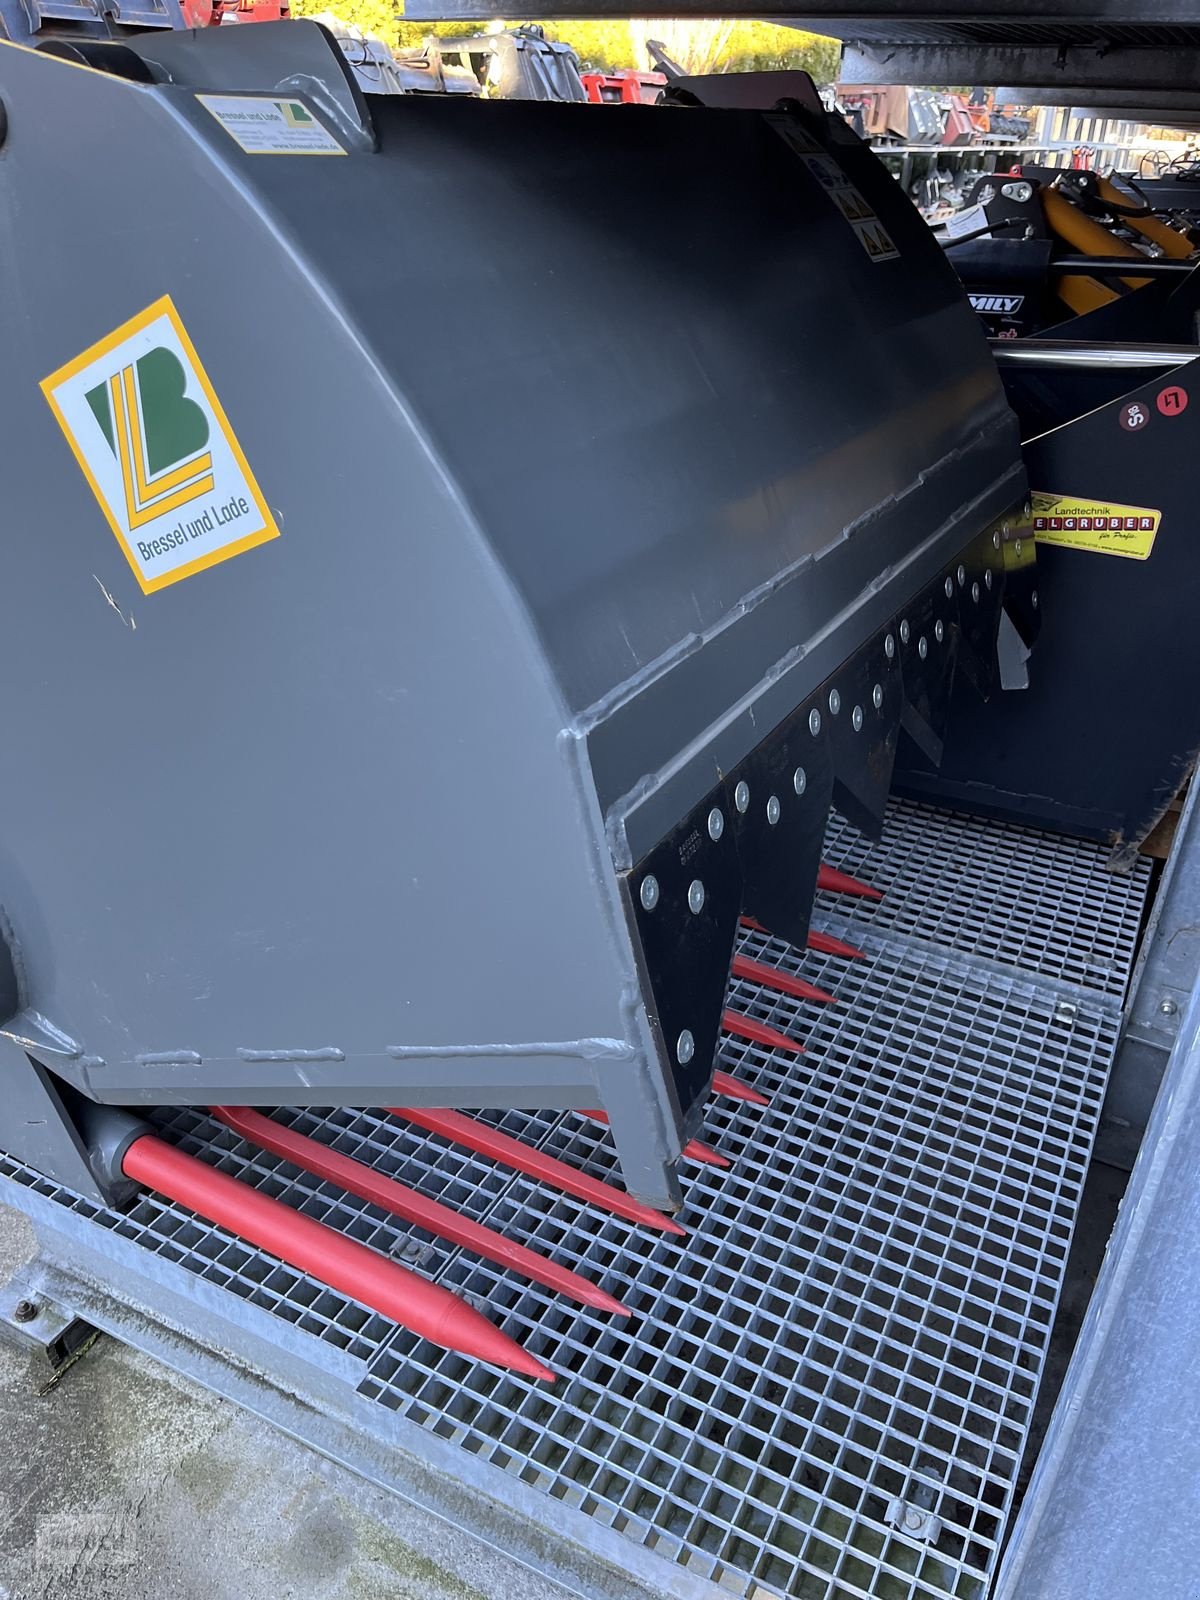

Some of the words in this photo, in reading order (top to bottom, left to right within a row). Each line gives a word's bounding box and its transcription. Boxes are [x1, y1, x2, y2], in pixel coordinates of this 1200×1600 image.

[246, 111, 263, 121] und
[1055, 507, 1111, 516] Landtechnik
[137, 523, 189, 562] Bressel
[185, 509, 215, 540] und
[211, 496, 250, 527] Lade
